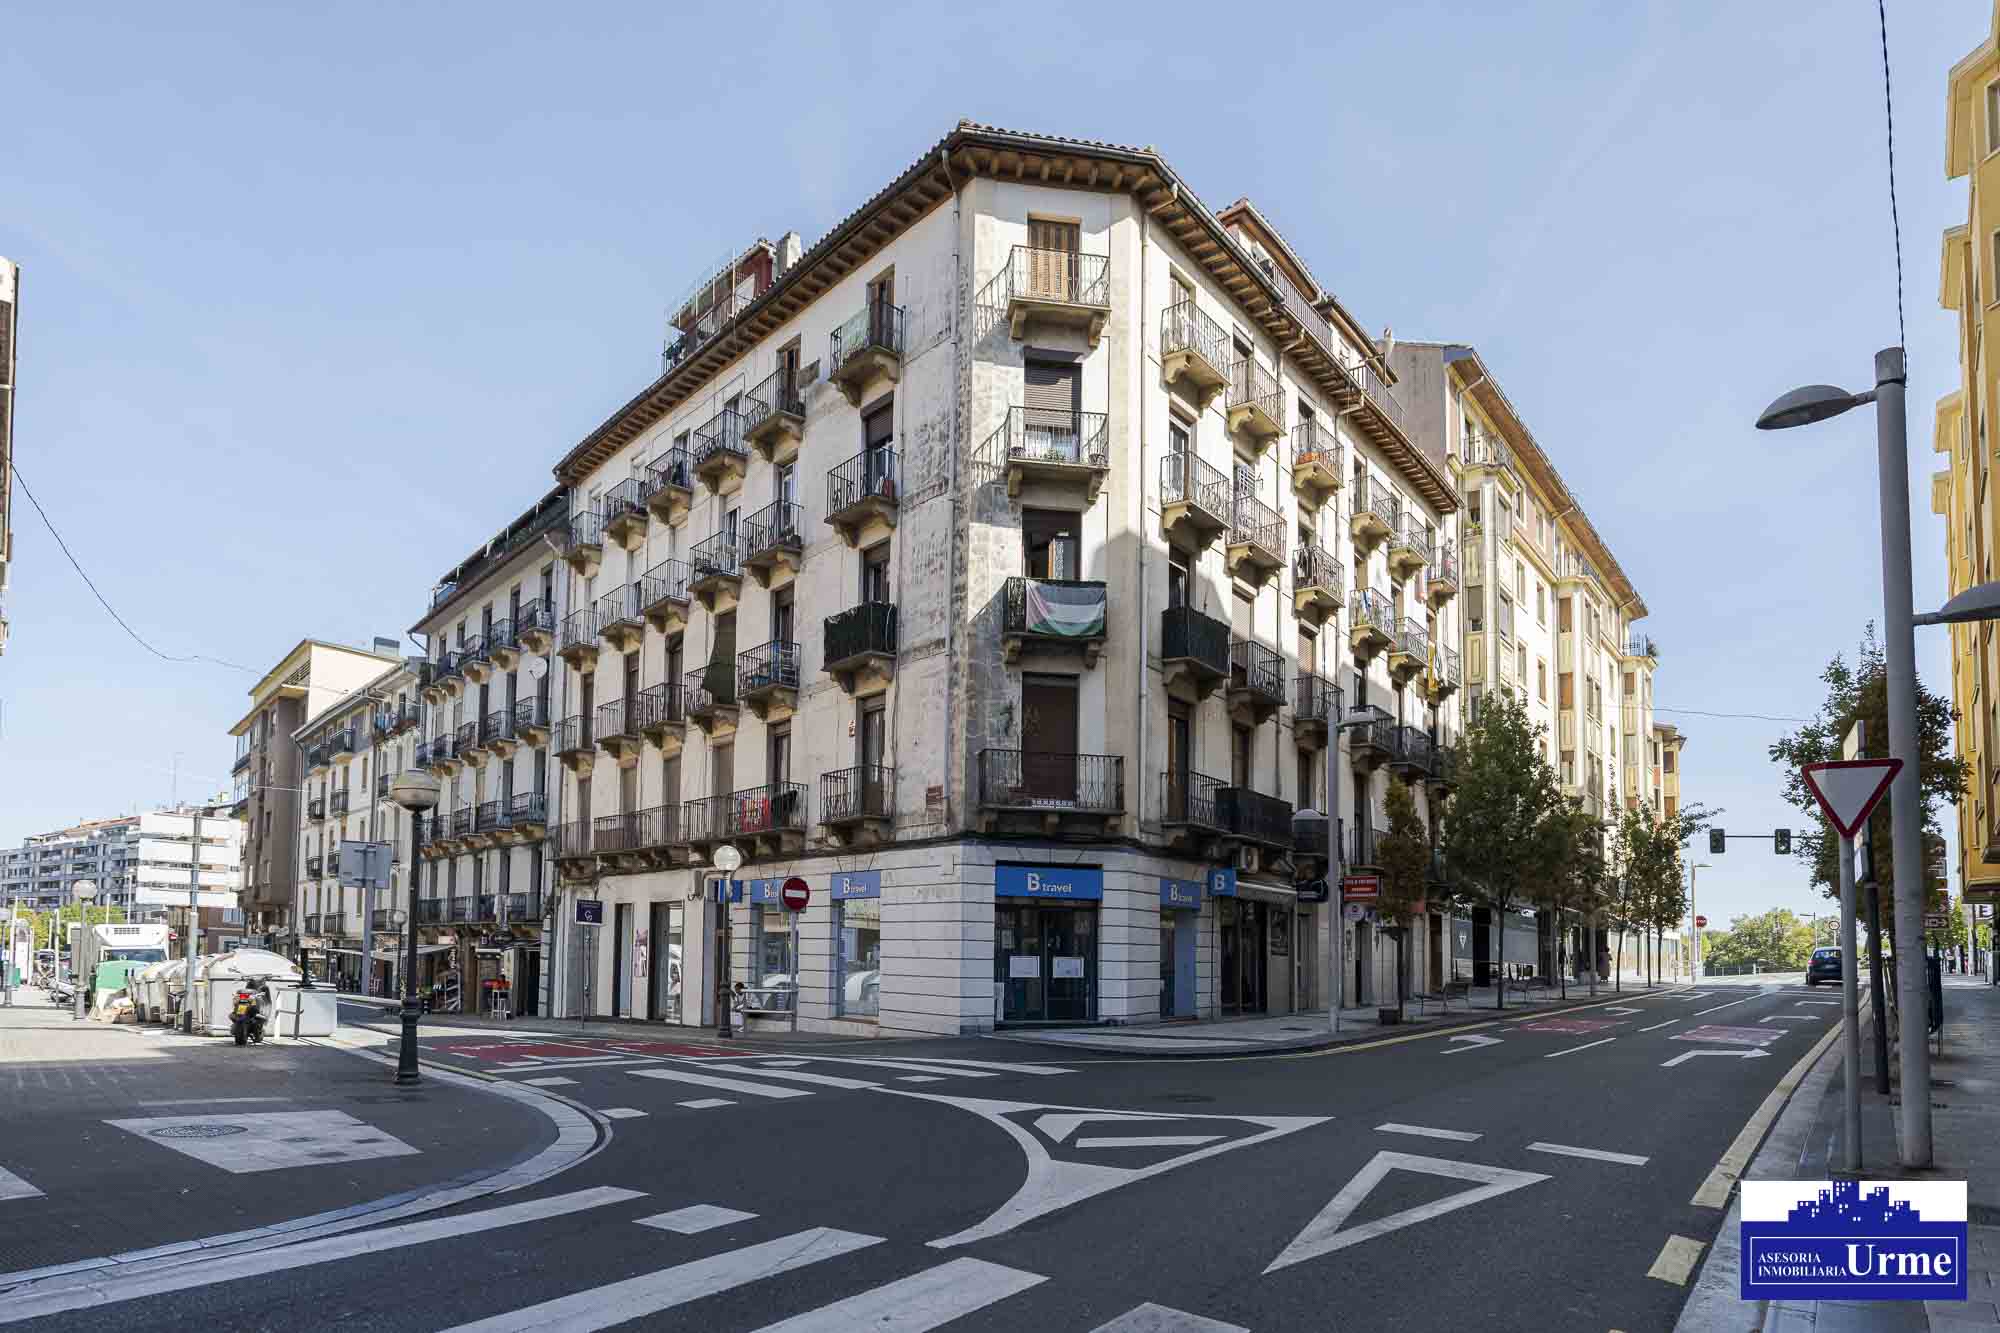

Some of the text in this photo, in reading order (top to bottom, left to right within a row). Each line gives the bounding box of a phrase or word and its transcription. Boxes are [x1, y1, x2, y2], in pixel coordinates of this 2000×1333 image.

[843, 878, 867, 894] B travel
[1027, 872, 1072, 893] B travel
[1215, 874, 1225, 890] B
